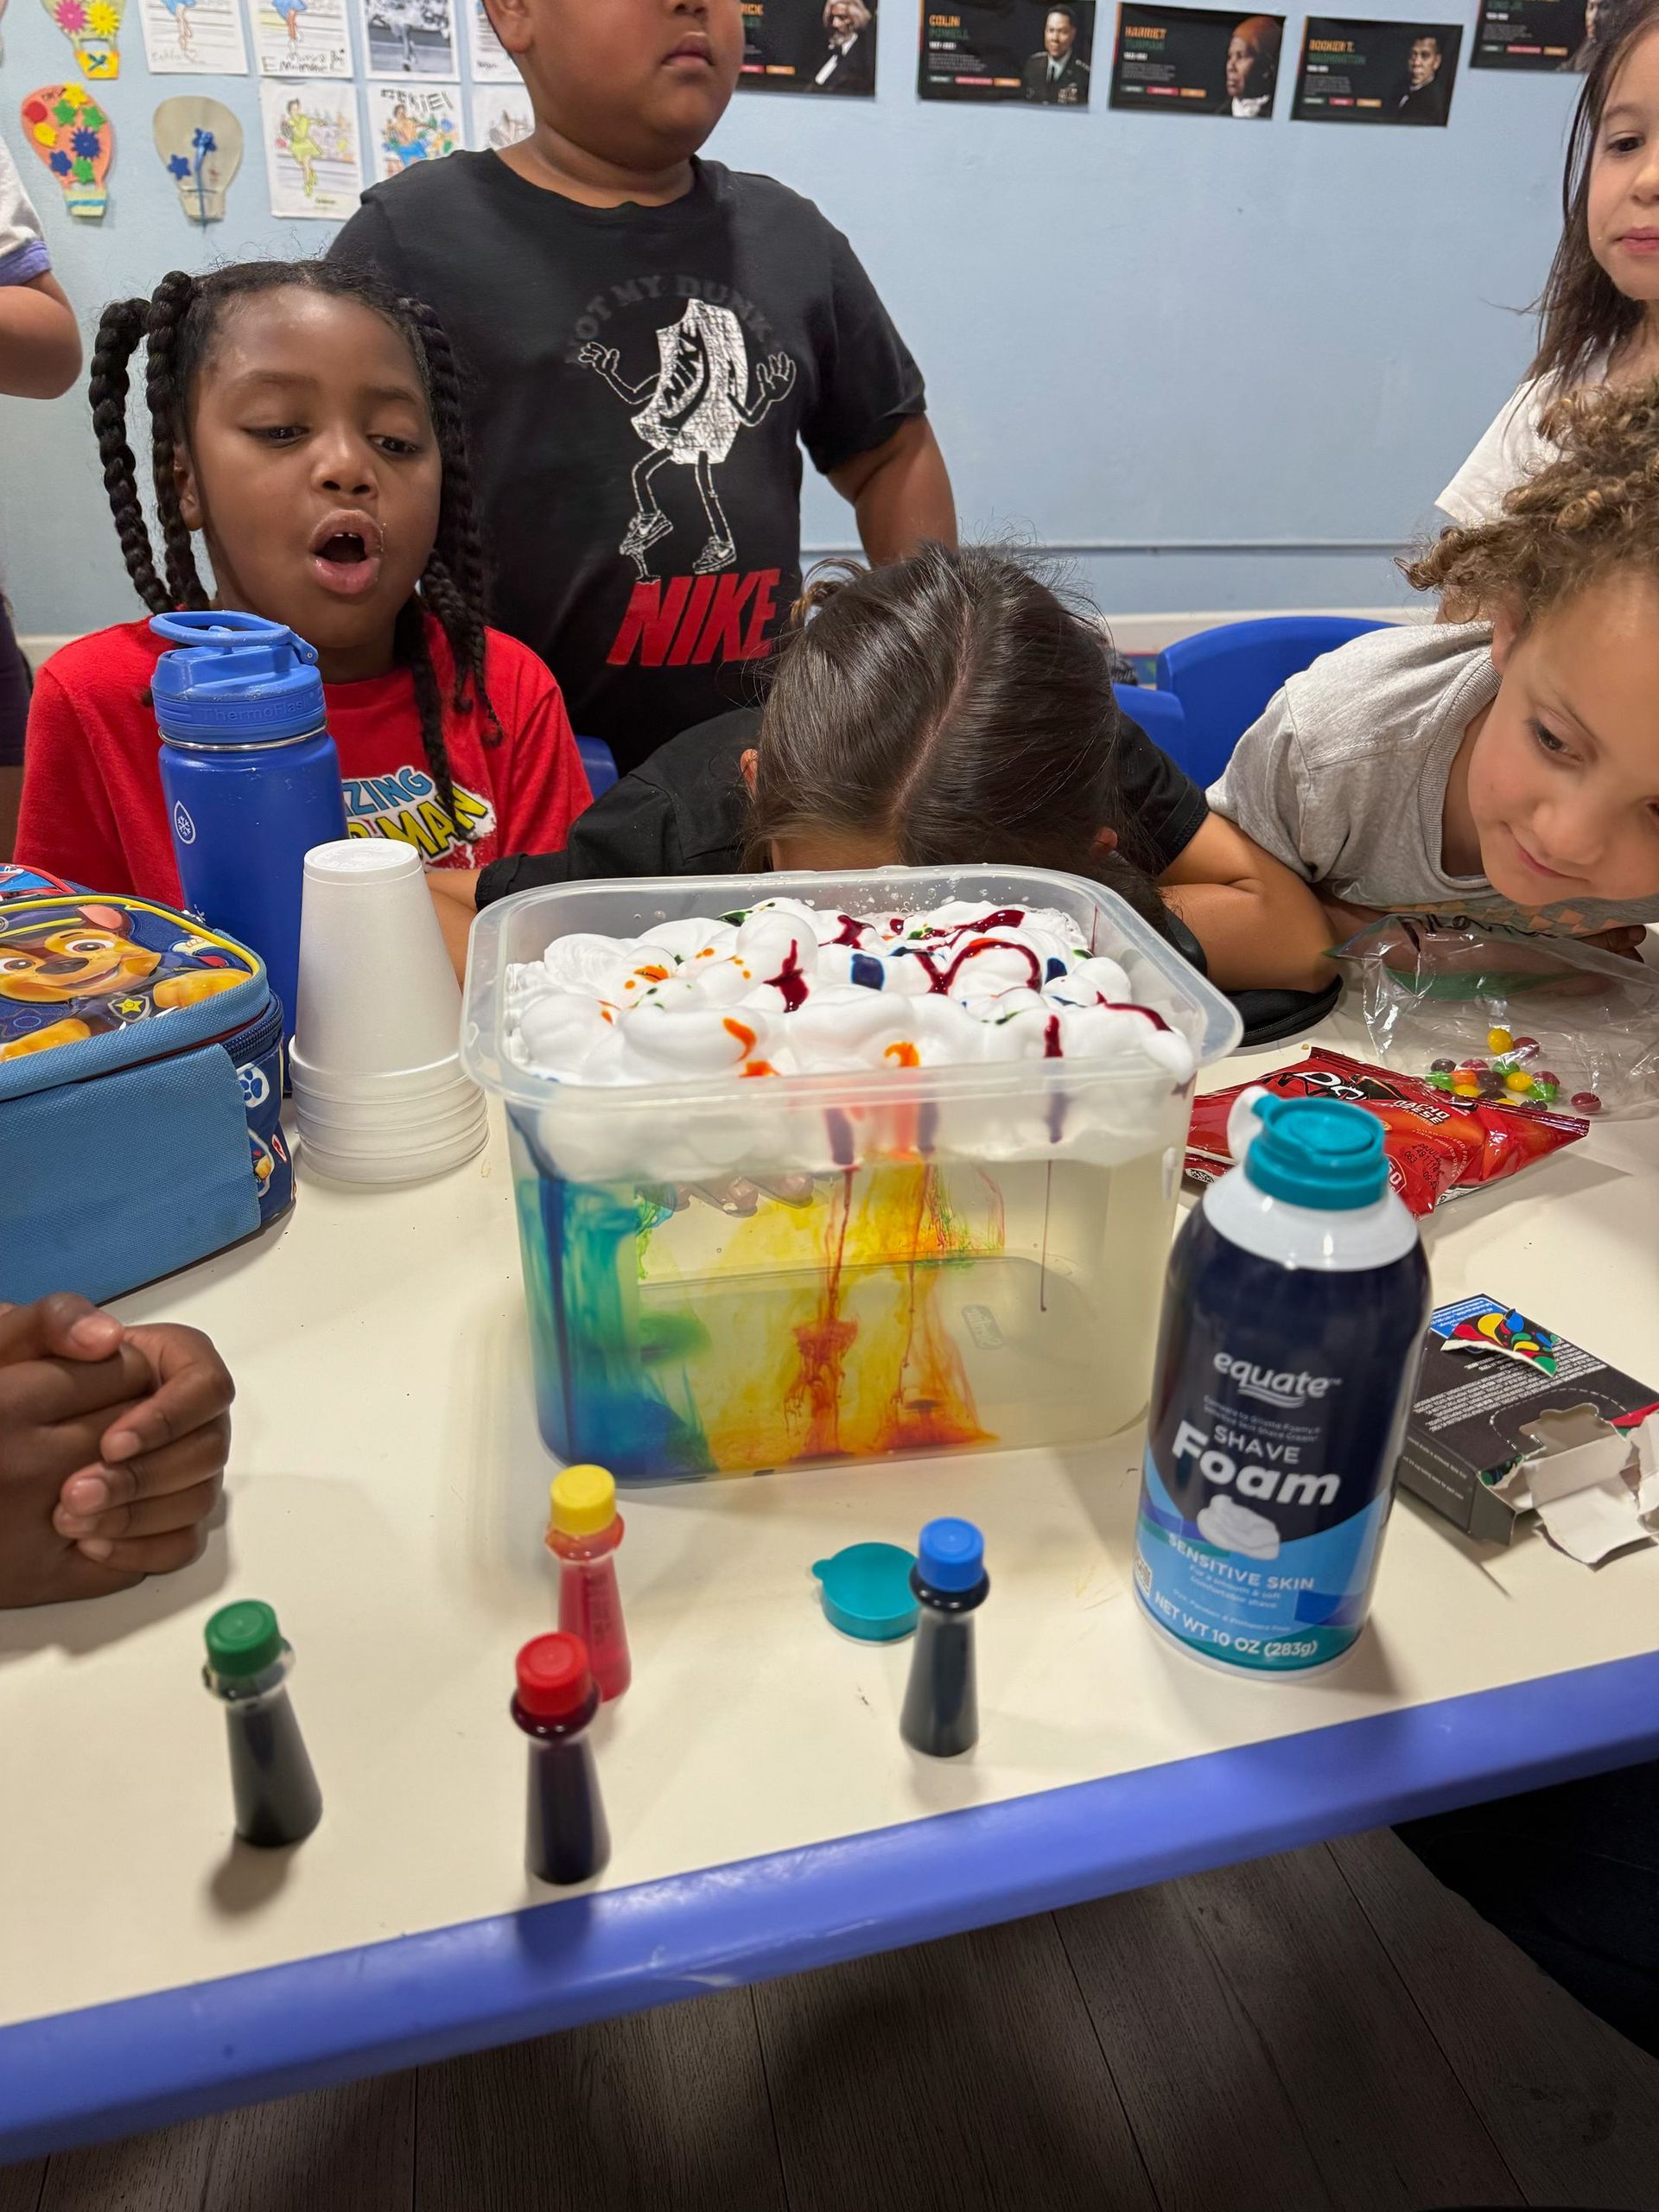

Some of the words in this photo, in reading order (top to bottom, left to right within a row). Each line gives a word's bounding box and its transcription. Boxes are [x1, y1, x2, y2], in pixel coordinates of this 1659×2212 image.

[929, 15, 961, 28] COLIN
[1125, 26, 1166, 40] HARRIET
[610, 274, 663, 307] MY
[606, 568, 782, 667] NIKE
[343, 767, 433, 817] ZING
[1393, 1100, 1451, 1120] NACHO
[1172, 1420, 1341, 1506] Foam
[1213, 1425, 1301, 1465] SHAVE
[1167, 1533, 1262, 1587] SENSITIVE
[1266, 1575, 1315, 1591] SKIN
[1154, 1589, 1181, 1621] NET
[1181, 1611, 1210, 1638] WT
[1211, 1629, 1231, 1648] 10
[1233, 1637, 1261, 1656] OZ
[1262, 1640, 1319, 1659] (283g)
